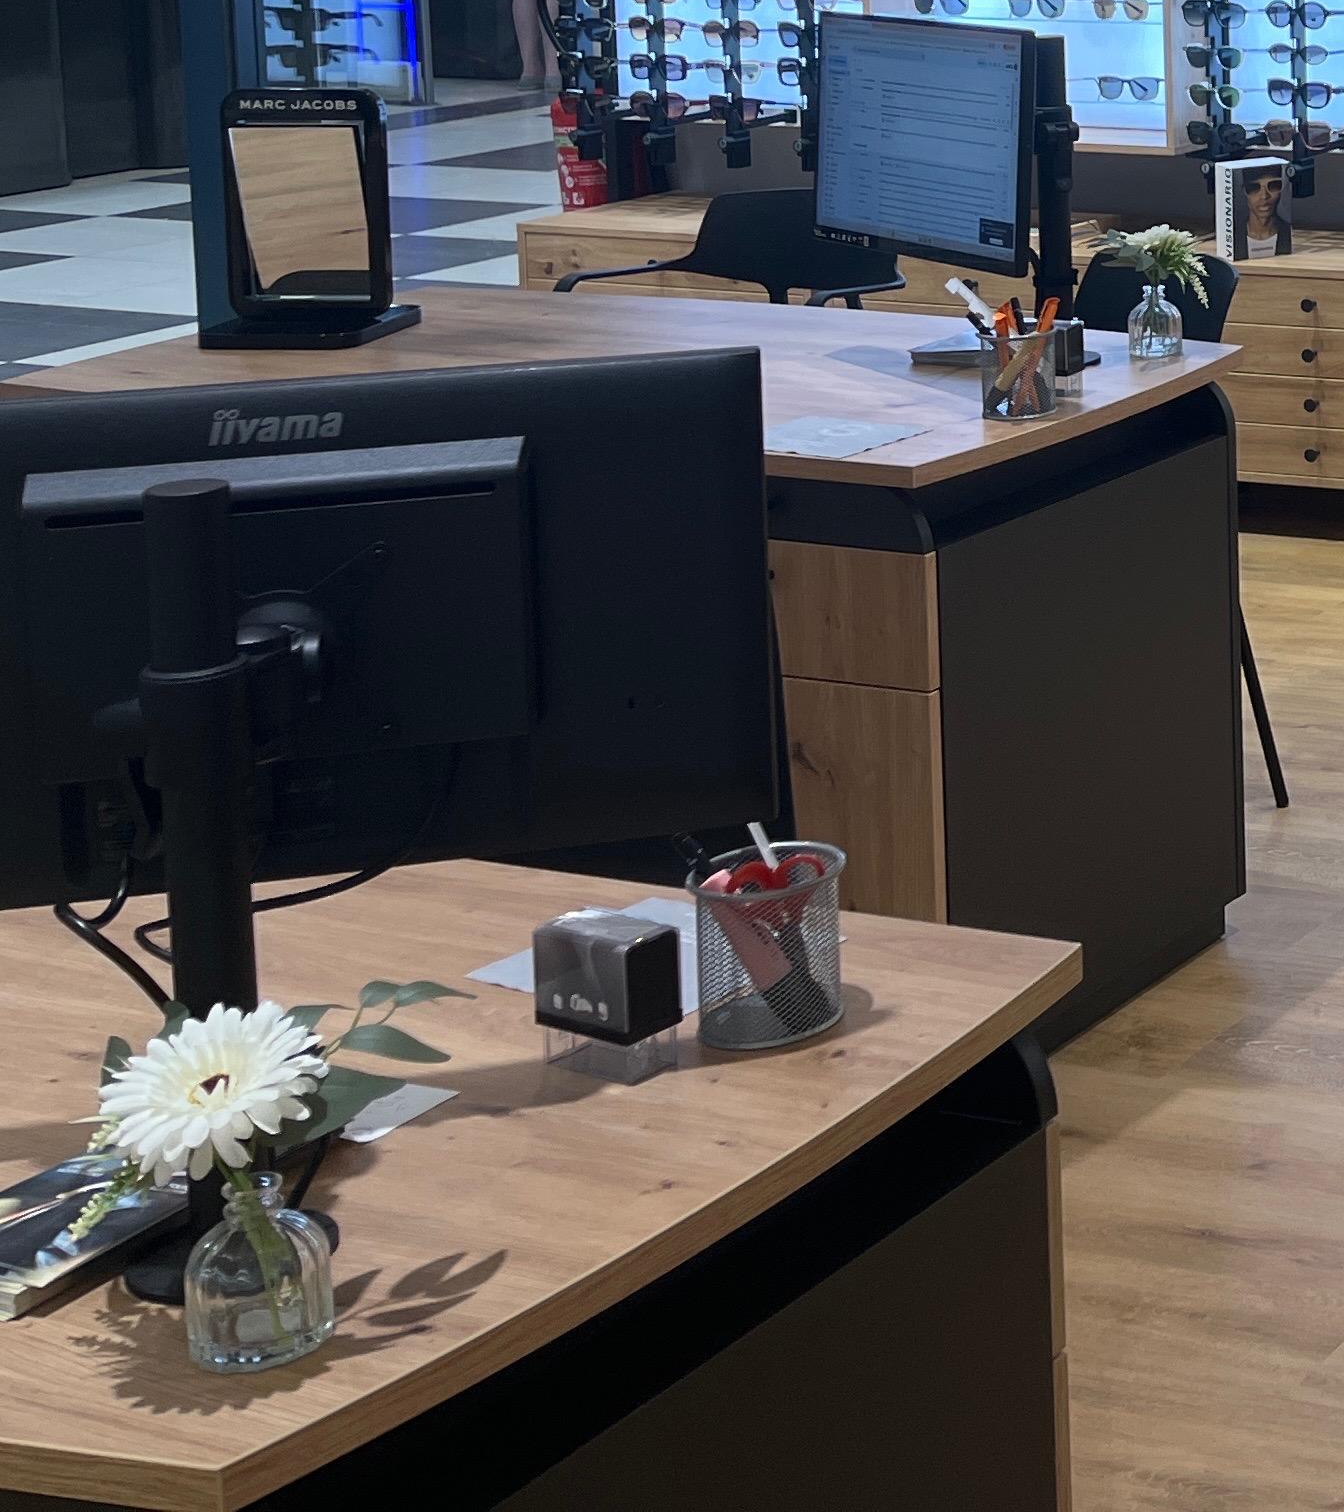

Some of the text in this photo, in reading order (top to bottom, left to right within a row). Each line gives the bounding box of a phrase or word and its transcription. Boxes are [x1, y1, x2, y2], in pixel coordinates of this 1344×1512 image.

[240, 99, 357, 110] MARC JACOBS
[1224, 168, 1233, 257] VISIONARIO
[208, 408, 344, 446] iiyama
